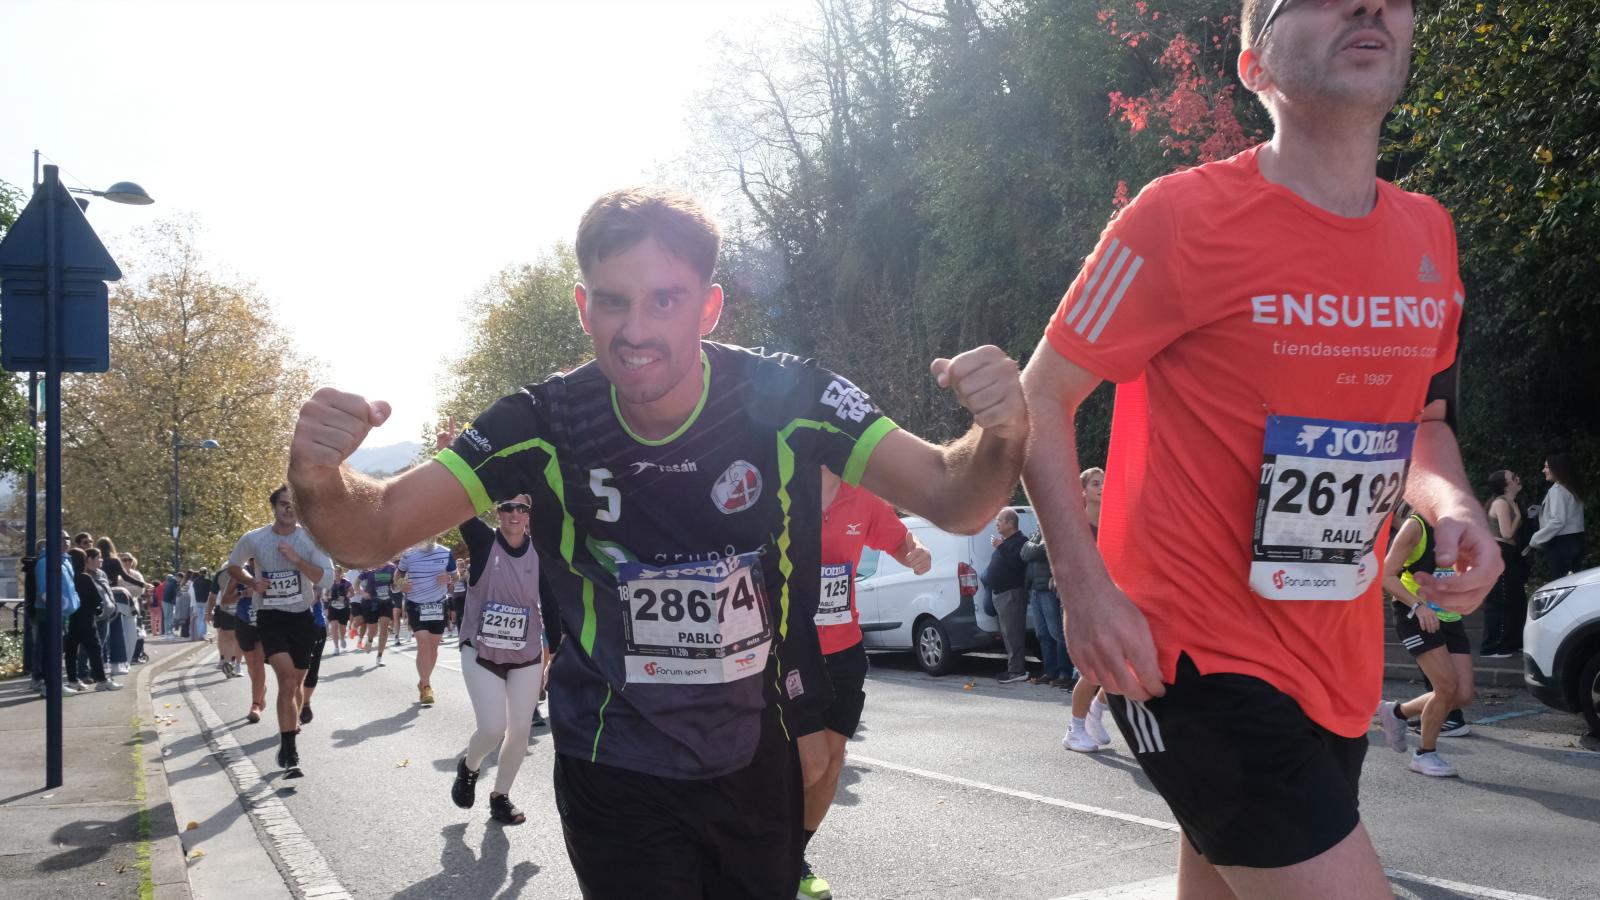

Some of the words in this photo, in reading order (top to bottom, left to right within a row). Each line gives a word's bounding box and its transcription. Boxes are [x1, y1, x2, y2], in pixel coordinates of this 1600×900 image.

[1250, 293, 1447, 329] ENSUEÑOS
[1336, 373, 1358, 385] Est.
[1363, 373, 1393, 386] 1987
[589, 468, 622, 522] 5
[1272, 469, 1400, 517] 26192
[1321, 529, 1364, 544] RAUL
[264, 578, 298, 590] 1124
[617, 585, 630, 601] 18
[633, 576, 755, 623] 28674
[485, 613, 524, 629] 22161
[678, 631, 723, 644] PABLO
